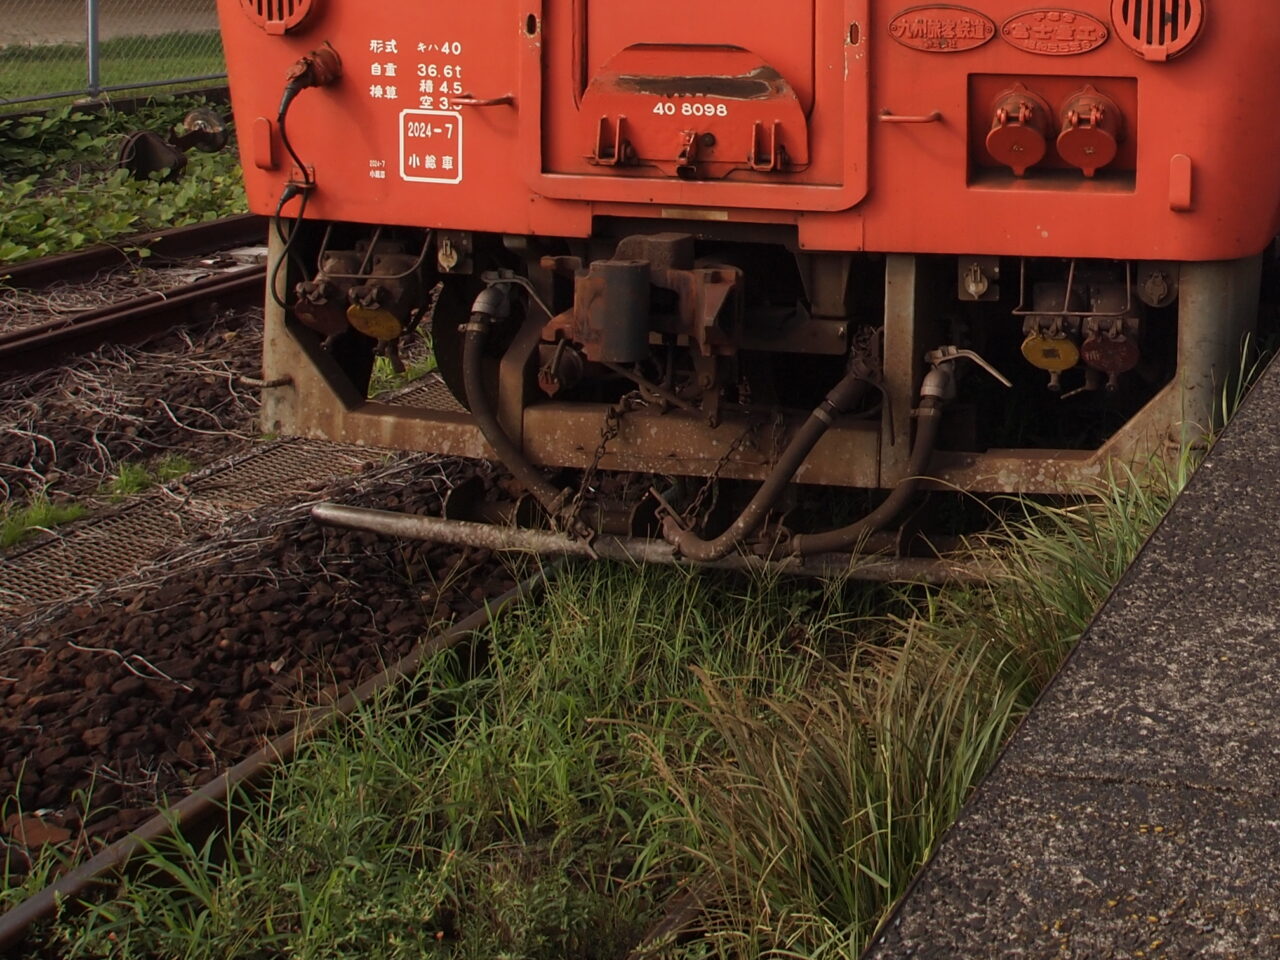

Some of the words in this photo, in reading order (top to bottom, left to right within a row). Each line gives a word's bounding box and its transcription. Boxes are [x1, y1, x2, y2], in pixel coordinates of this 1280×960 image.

[369, 39, 398, 54] 形式
[417, 41, 461, 55] キハ40
[370, 62, 398, 76] 自重
[417, 64, 461, 79] 36.6t
[439, 81, 462, 94] 4.5
[419, 95, 433, 109] 空
[653, 102, 676, 115] 40
[681, 102, 728, 116] 8098
